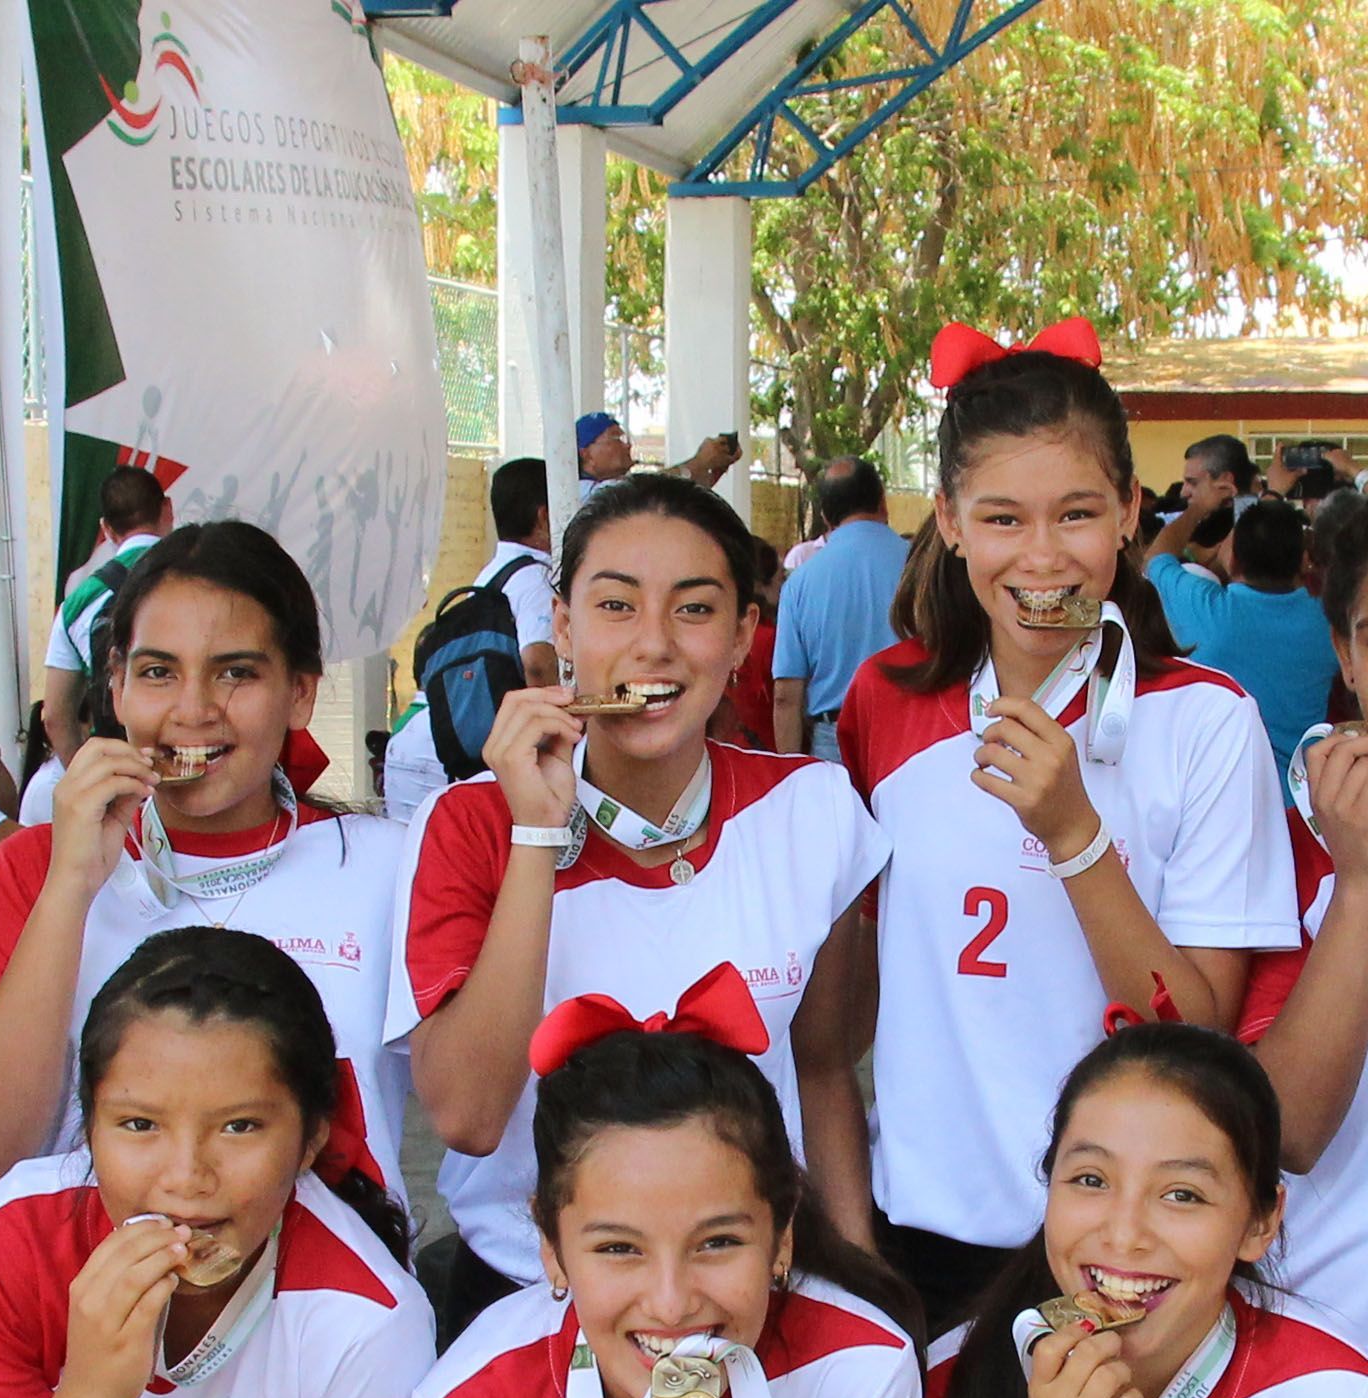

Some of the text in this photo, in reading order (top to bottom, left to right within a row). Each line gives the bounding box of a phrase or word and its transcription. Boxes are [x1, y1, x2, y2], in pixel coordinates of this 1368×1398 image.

[170, 105, 265, 145] JUEGOS
[170, 156, 287, 195] ESCOLARES
[289, 163, 311, 195] DE
[313, 165, 334, 198] LA
[174, 199, 273, 224] Sistema
[269, 938, 325, 951] LIMA
[957, 886, 1009, 978] 2
